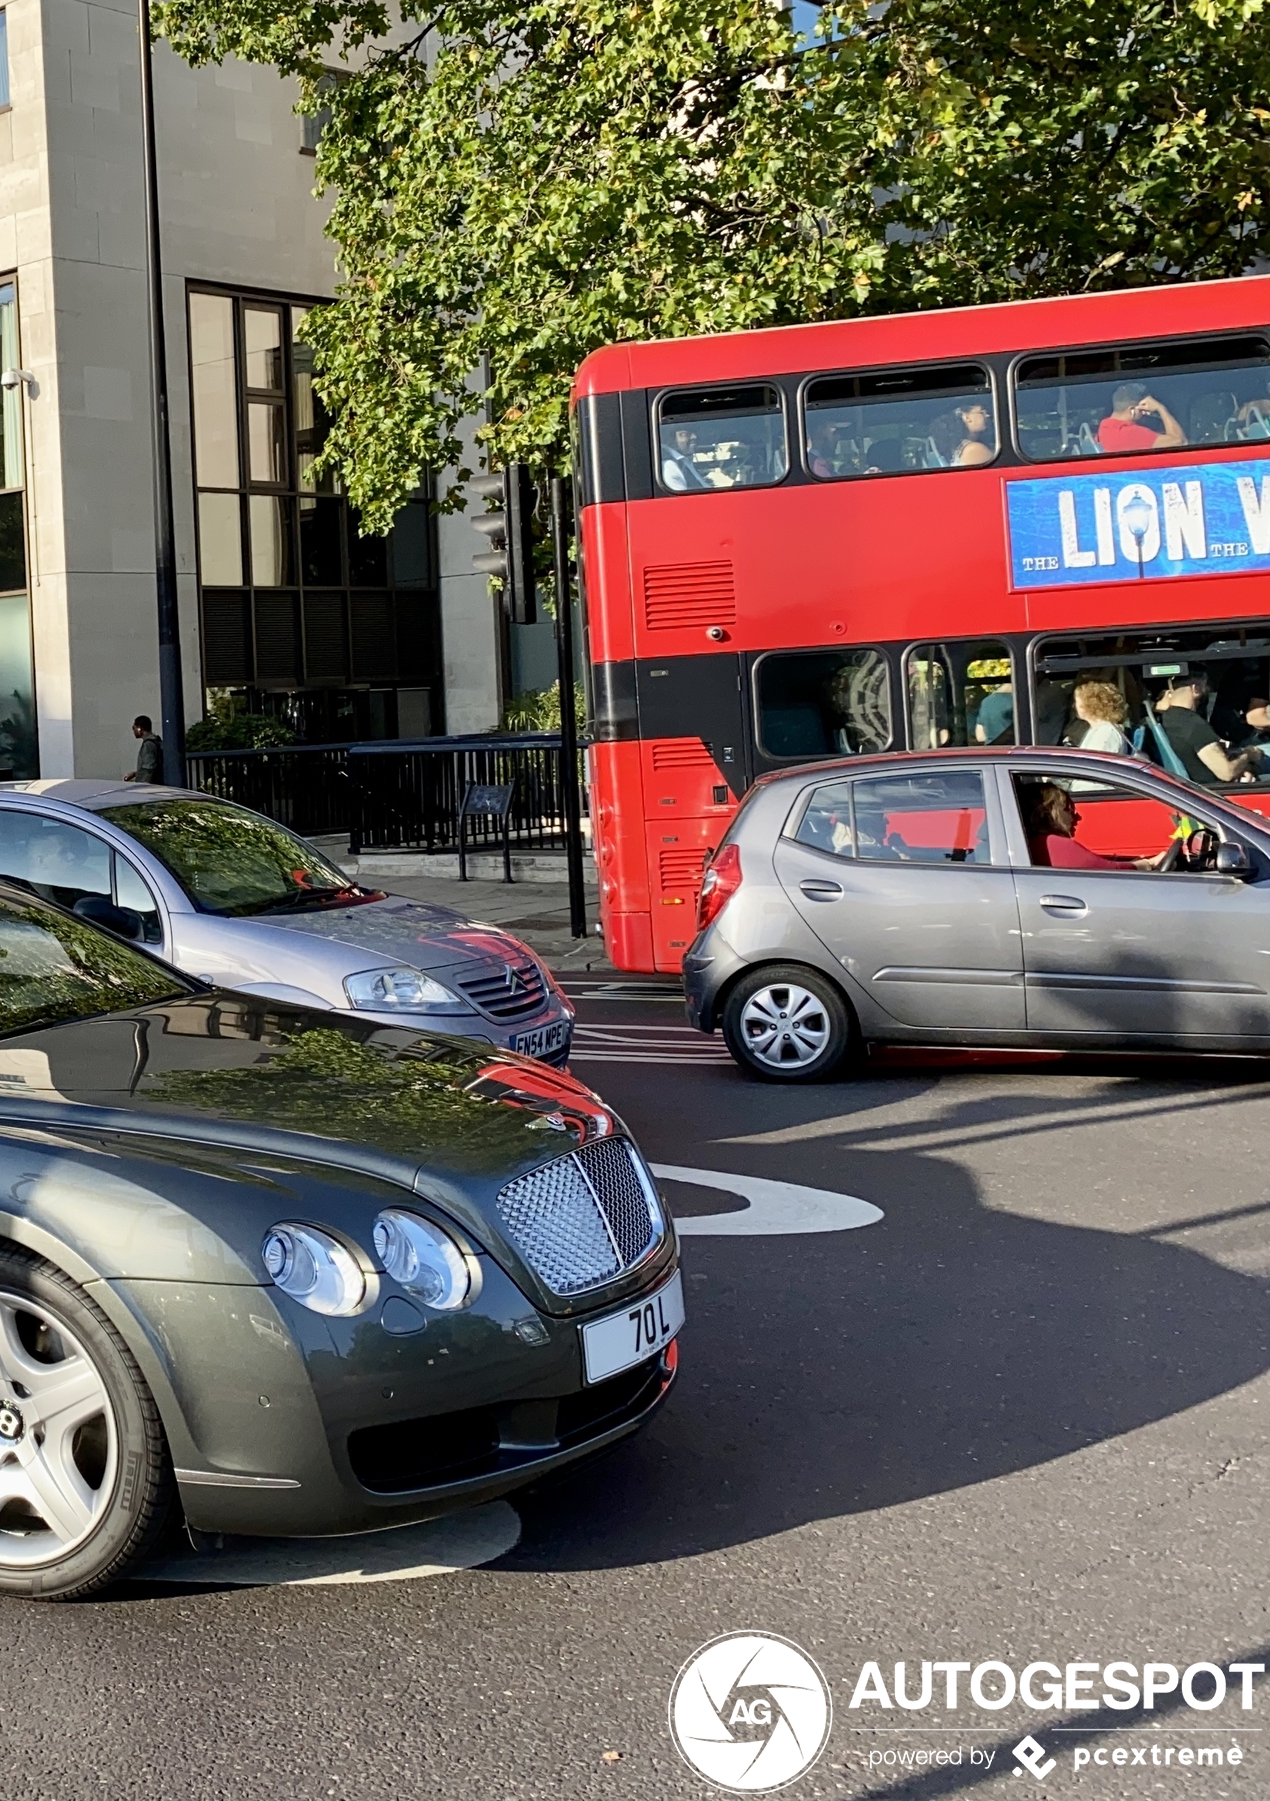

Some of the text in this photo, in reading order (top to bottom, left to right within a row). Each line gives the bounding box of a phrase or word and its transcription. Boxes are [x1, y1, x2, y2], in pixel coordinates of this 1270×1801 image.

[1022, 556, 1059, 571] THE
[1058, 480, 1207, 568] LION
[1210, 542, 1248, 558] THE
[545, 1024, 563, 1050] MPE
